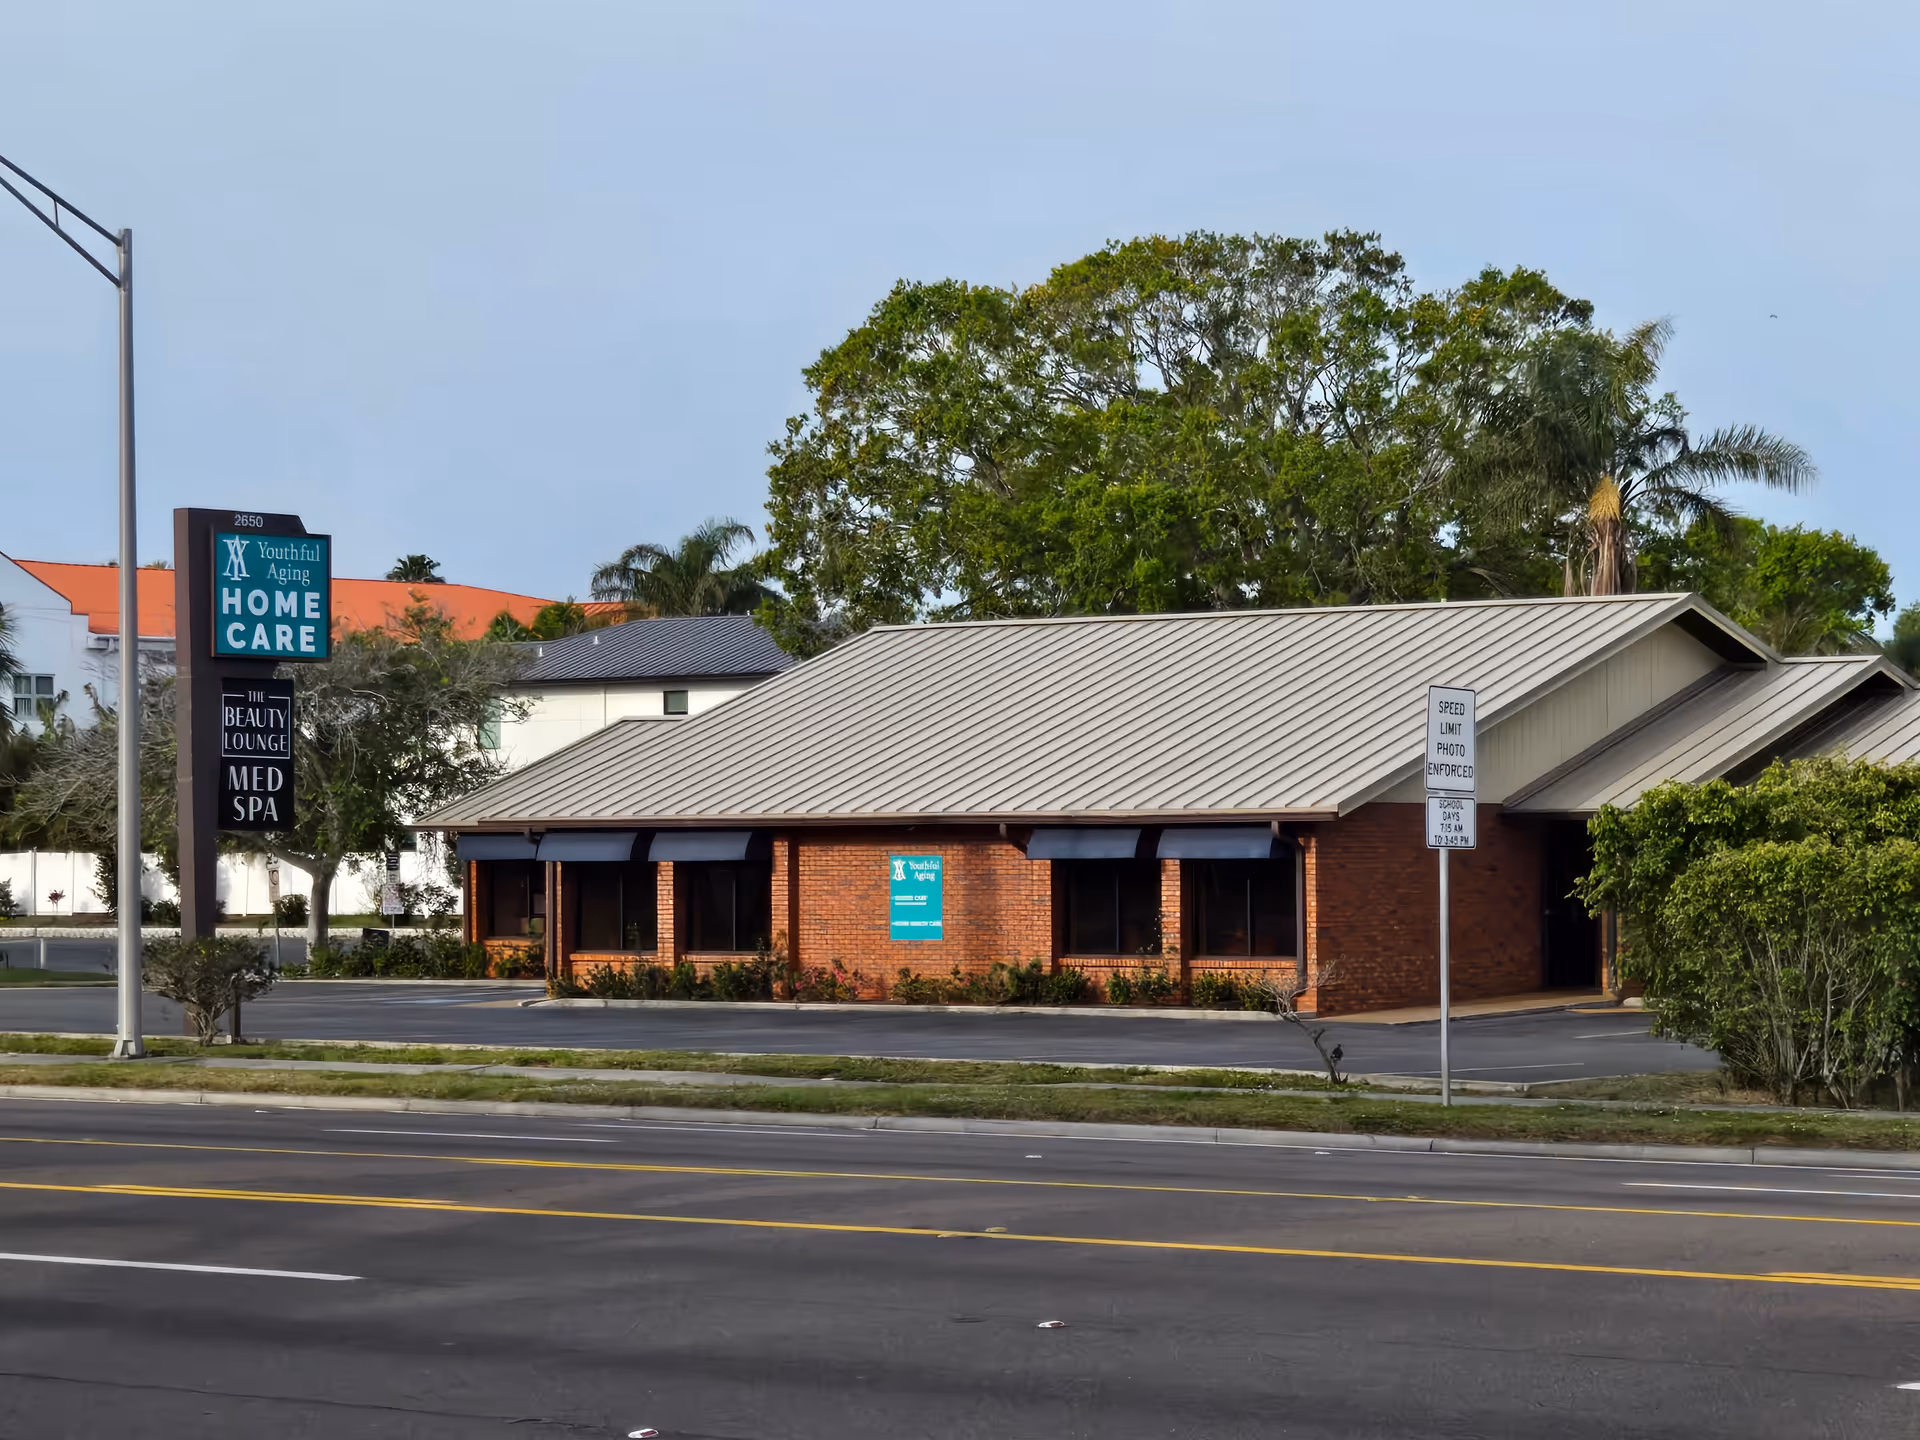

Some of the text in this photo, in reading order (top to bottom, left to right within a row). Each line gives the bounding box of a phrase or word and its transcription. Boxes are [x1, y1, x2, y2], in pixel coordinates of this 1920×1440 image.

[234, 514, 264, 527] 2650
[257, 541, 320, 561] Youthful
[266, 562, 310, 586] Aging
[222, 587, 320, 618] HOME
[226, 622, 315, 652] CARE
[248, 690, 265, 702] THE
[1438, 700, 1465, 715] SPEED
[224, 706, 287, 728] BEAUTY
[1440, 722, 1462, 735] LIMIT
[224, 732, 287, 751] LOUNGE
[1437, 742, 1465, 757] PHOTO
[1428, 762, 1473, 778] ENFORCED
[228, 765, 283, 791] MED
[233, 796, 278, 821] SPA
[1439, 799, 1464, 810] SCHOOL
[1442, 811, 1460, 821] DAYS
[1454, 824, 1463, 833] AM
[1434, 835, 1443, 844] TO
[1460, 836, 1469, 845] PM
[908, 860, 940, 870] Youthful
[914, 871, 935, 881] Aging
